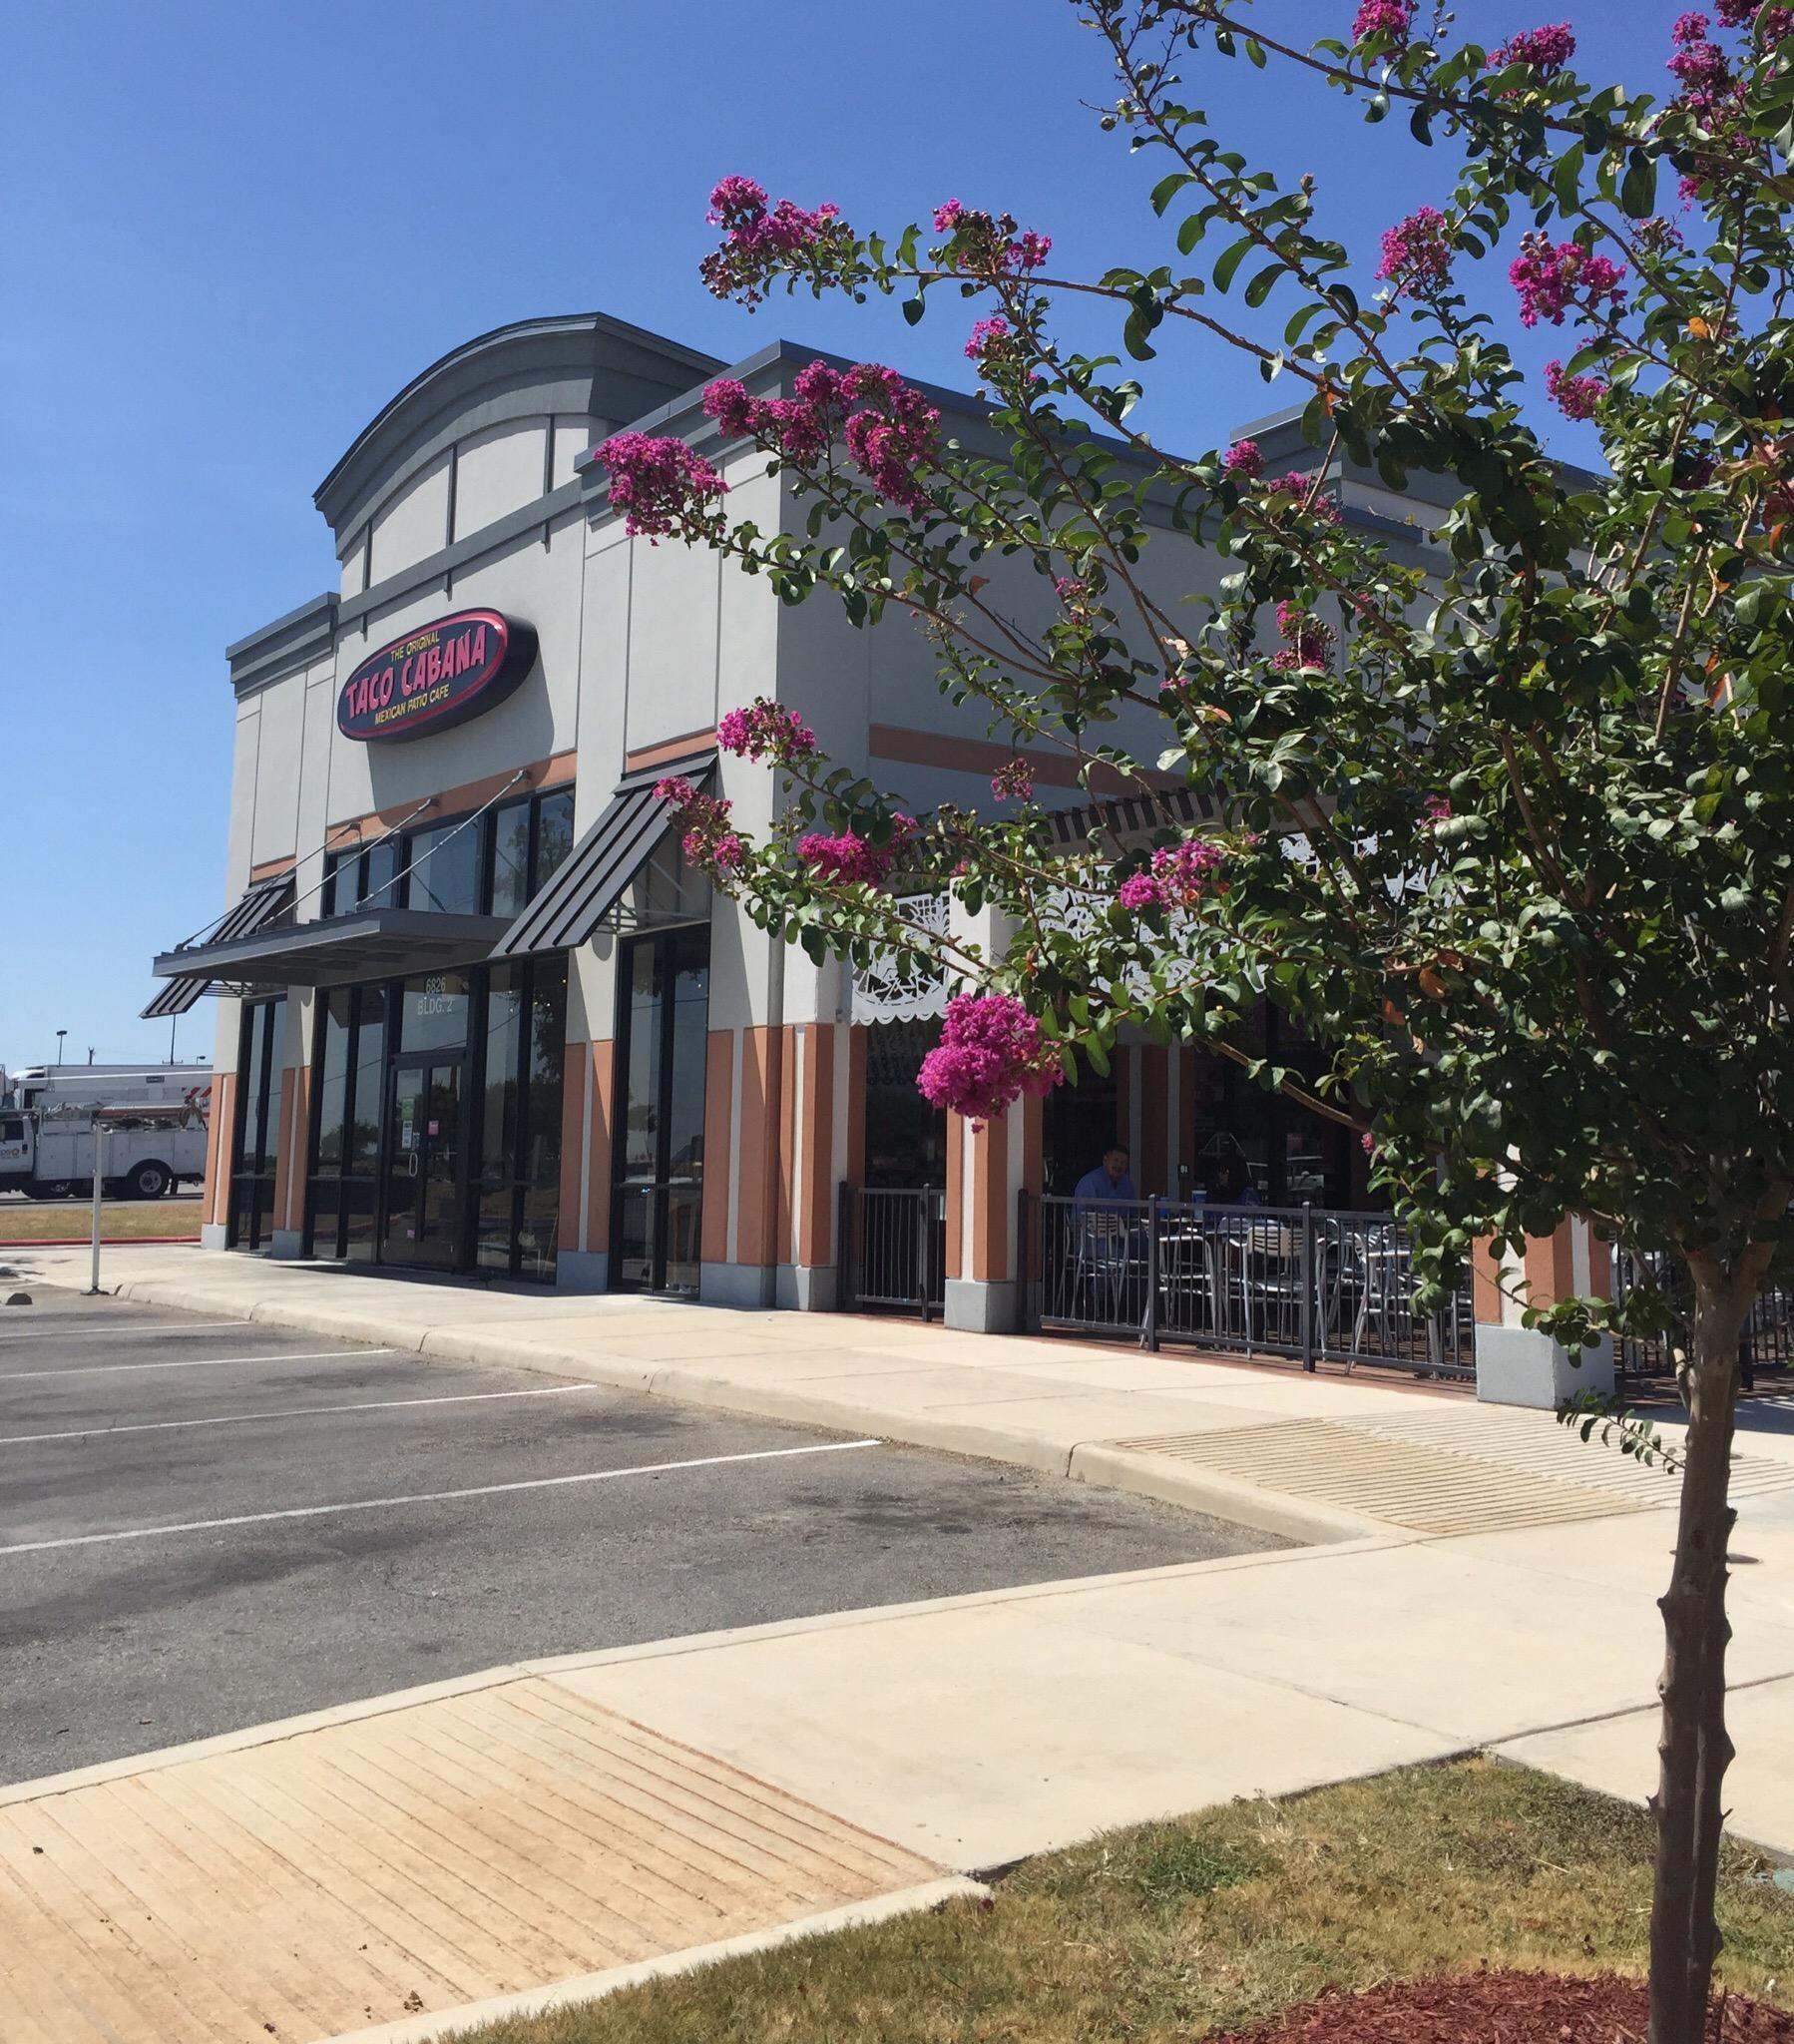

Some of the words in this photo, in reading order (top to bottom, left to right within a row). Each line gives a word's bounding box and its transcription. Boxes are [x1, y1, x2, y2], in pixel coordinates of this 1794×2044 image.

[390, 646, 404, 663] THE
[406, 631, 440, 656] ORIGINAL
[345, 667, 394, 720] TACO
[401, 625, 486, 698] CABANA
[374, 703, 407, 726] MEXICAN
[407, 693, 428, 714] PATIO
[430, 684, 450, 704] CAFE
[426, 976, 446, 995] 6826
[417, 997, 445, 1015] BLDG.
